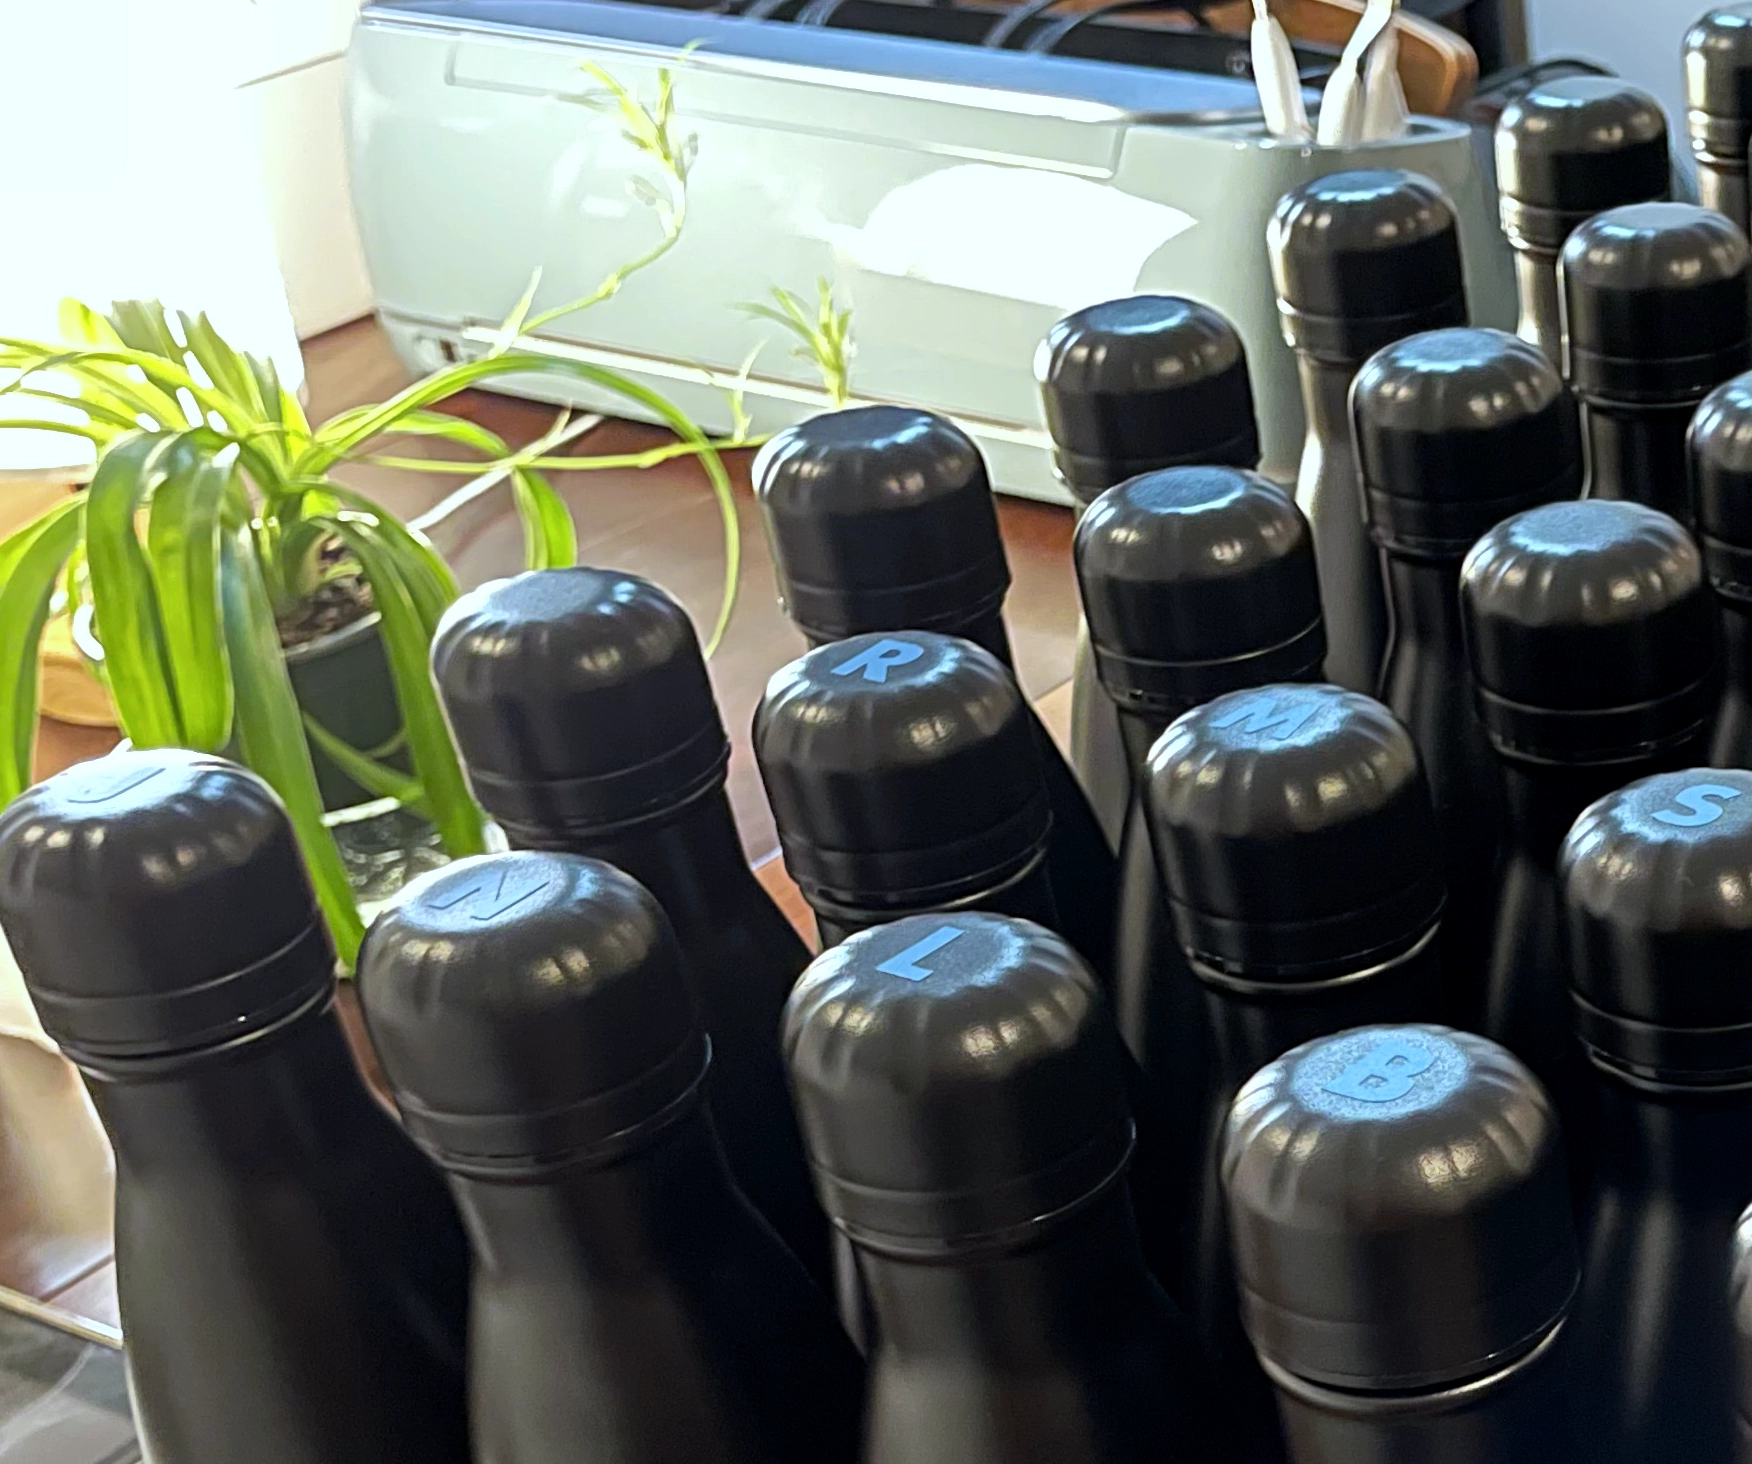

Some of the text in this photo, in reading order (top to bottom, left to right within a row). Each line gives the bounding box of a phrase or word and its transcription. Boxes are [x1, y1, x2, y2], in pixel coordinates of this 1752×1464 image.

[831, 637, 925, 685] R
[1208, 696, 1325, 743] M
[1649, 781, 1742, 829] S
[426, 868, 550, 922] N
[875, 925, 965, 983] L
[1320, 1038, 1440, 1111] B
